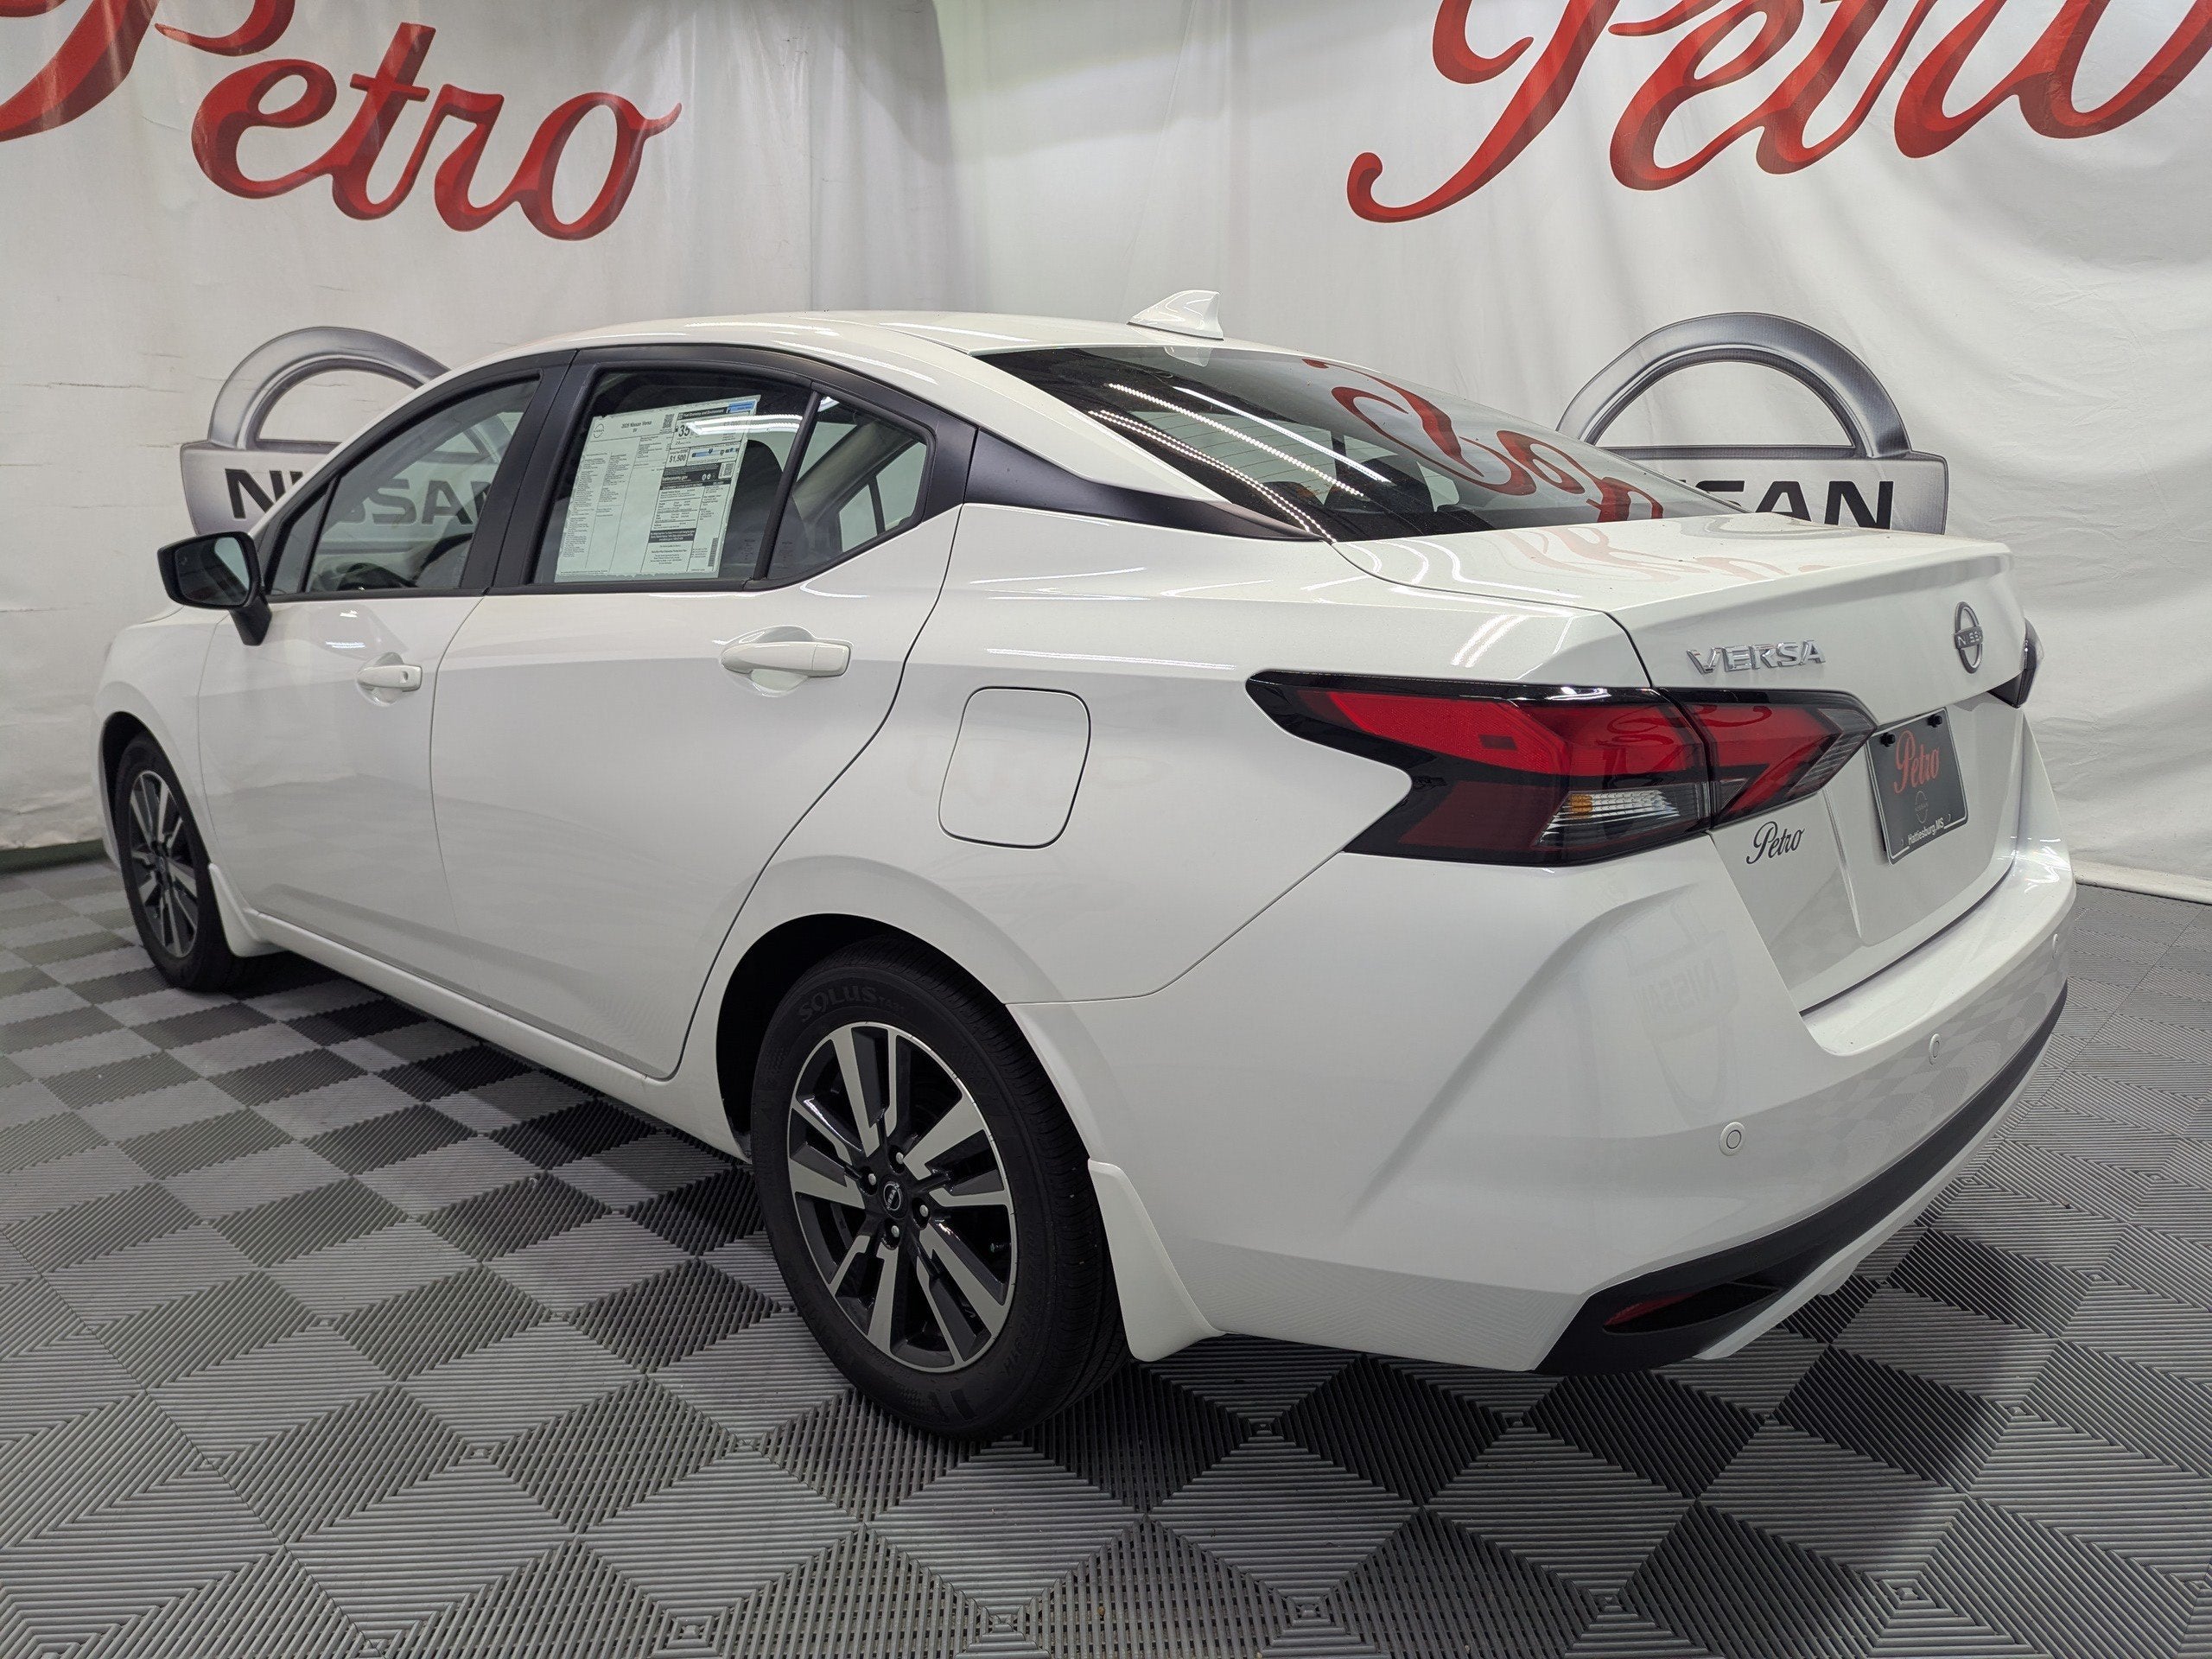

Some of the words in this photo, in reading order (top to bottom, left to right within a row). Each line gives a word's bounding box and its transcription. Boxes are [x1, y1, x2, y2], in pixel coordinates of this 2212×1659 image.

[678, 424, 690, 437] 35
[1687, 640, 1826, 674] VERSA
[1894, 728, 1941, 794] Petro
[1746, 821, 1805, 865] Petro
[798, 986, 877, 1023] SOLUS
